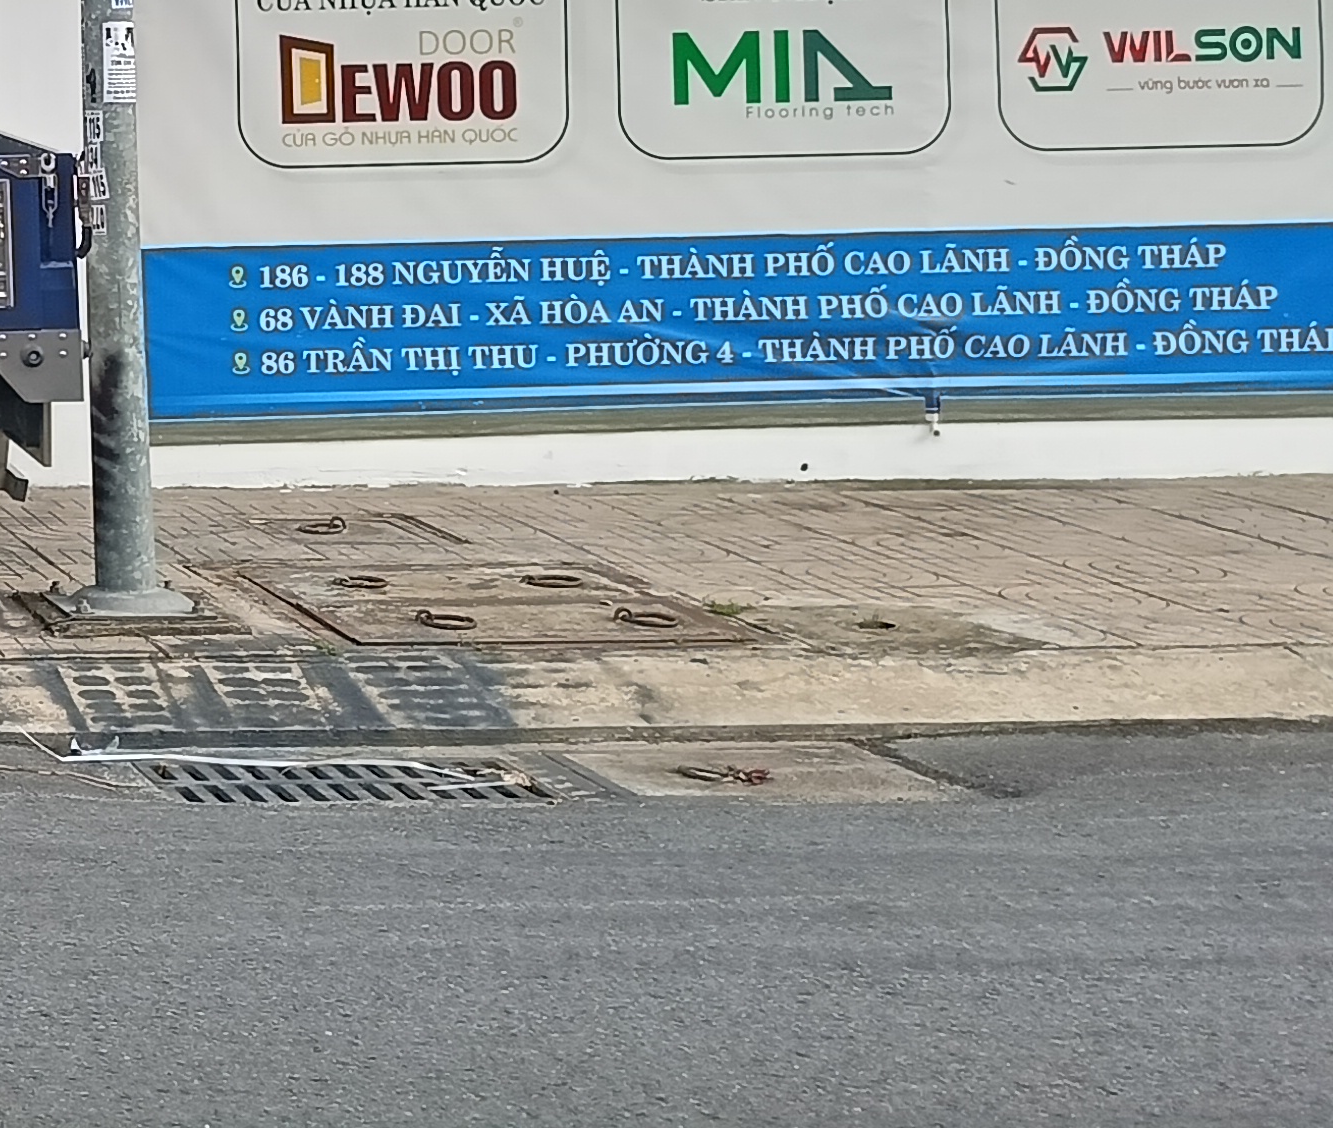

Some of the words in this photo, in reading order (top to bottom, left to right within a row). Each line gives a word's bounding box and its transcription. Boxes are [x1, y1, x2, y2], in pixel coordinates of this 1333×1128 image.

[419, 29, 516, 55] DOOR
[1103, 26, 1302, 63] WILSON
[1252, 77, 1271, 89] xa
[746, 105, 834, 121] Flooring
[846, 103, 895, 117] tech
[417, 125, 455, 145] HÀN
[259, 265, 309, 289] 186
[335, 262, 384, 288] 188
[392, 246, 531, 286] NGUYỄN
[540, 250, 611, 286] HUỆ
[637, 247, 754, 280] THÀNH
[765, 242, 834, 277] PHỐ
[844, 250, 911, 276] CAO
[919, 243, 1010, 274] LÃNH
[1034, 237, 1130, 272] ĐỒNG
[1137, 237, 1227, 270] THÁP
[259, 306, 293, 331] 68
[300, 299, 394, 332] VÀNH
[402, 303, 462, 328] ĐAI
[485, 296, 532, 327] XÃ
[540, 293, 611, 324] HÒA
[617, 299, 664, 322] AN
[690, 289, 808, 321] THÀNH
[817, 284, 887, 319] PHỐ
[897, 292, 963, 319] CAO
[971, 285, 1061, 317] LÃNH
[1086, 278, 1181, 313] ĐỒNG
[1188, 280, 1279, 312] THÁP
[260, 351, 295, 375] 86
[303, 336, 394, 373] TRẦN
[401, 346, 461, 376] THỊ
[468, 345, 538, 370] THU
[565, 332, 709, 367] PHƯỜNG
[716, 342, 734, 364] 4
[758, 331, 877, 363] THÀNH
[886, 328, 955, 361] PHỐ
[963, 333, 1031, 359] CAO
[1037, 326, 1128, 358] LÃNH
[1153, 318, 1249, 355] ĐỒNG
